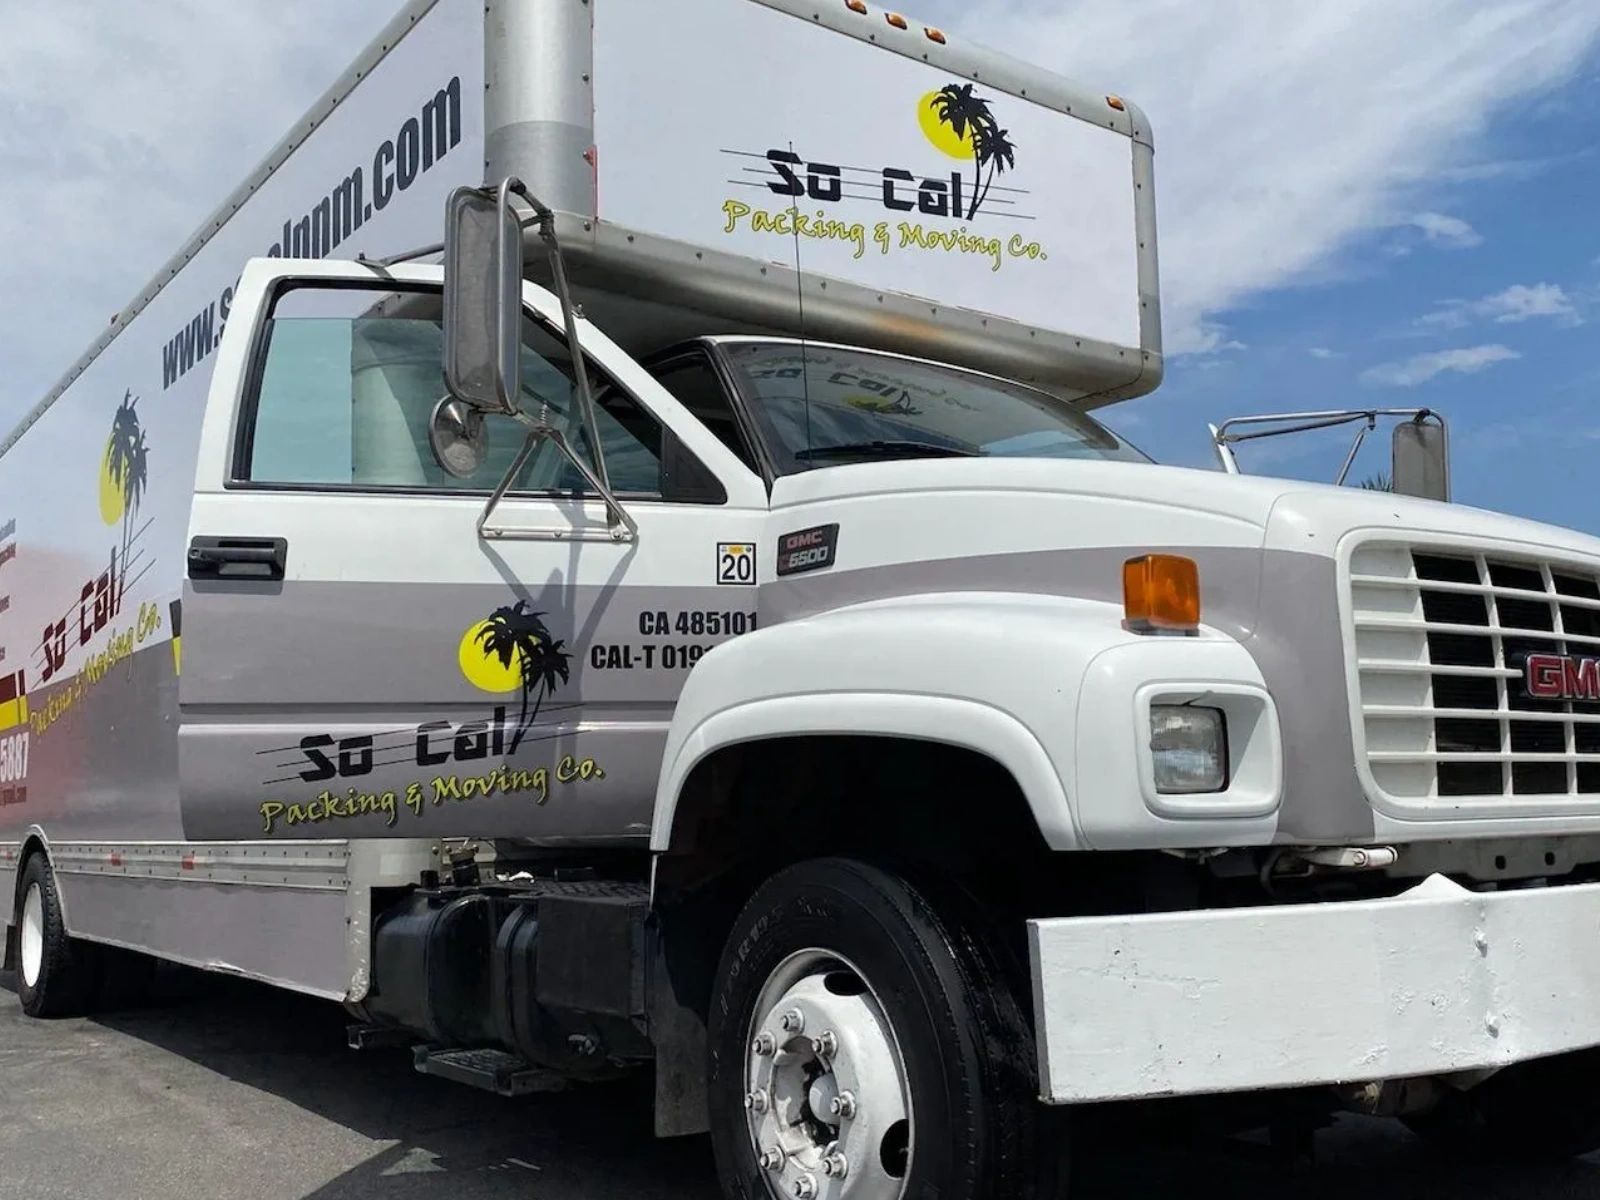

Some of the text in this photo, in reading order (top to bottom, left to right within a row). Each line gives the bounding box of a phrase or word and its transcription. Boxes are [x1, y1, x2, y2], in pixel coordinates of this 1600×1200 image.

[766, 149, 962, 219] So Cal
[722, 199, 1048, 272] Packing & Moving Co.
[722, 554, 750, 580] 20
[786, 531, 822, 549] GMC
[42, 546, 116, 682] So Cal
[639, 611, 757, 635] CA 485101
[591, 645, 656, 669] CAL-T
[1526, 653, 1600, 700] GM
[299, 705, 505, 782] So Cal
[259, 755, 605, 833] Packing & Moving Co.
